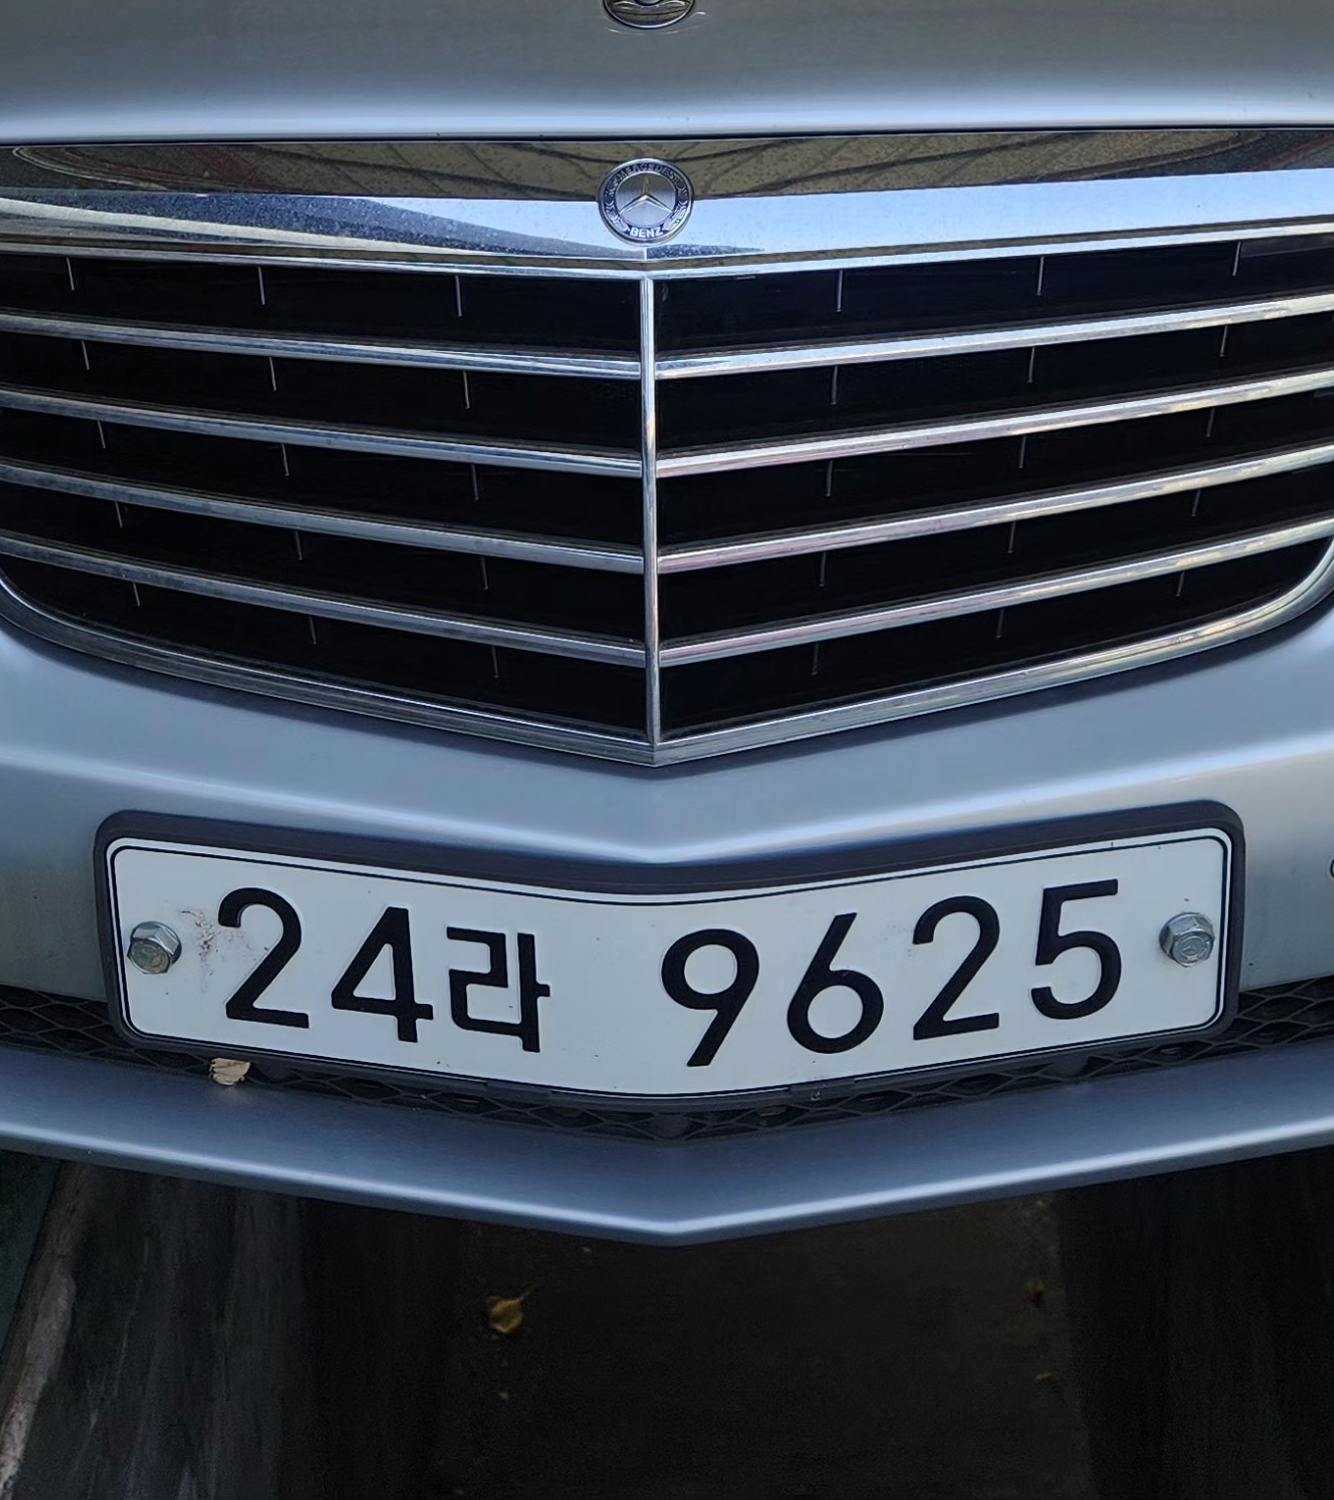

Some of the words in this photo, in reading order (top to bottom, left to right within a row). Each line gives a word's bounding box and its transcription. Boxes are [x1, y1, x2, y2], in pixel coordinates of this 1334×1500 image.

[629, 226, 664, 238] BENZ
[215, 886, 554, 1054] 24라
[660, 877, 1121, 1068] 9625
